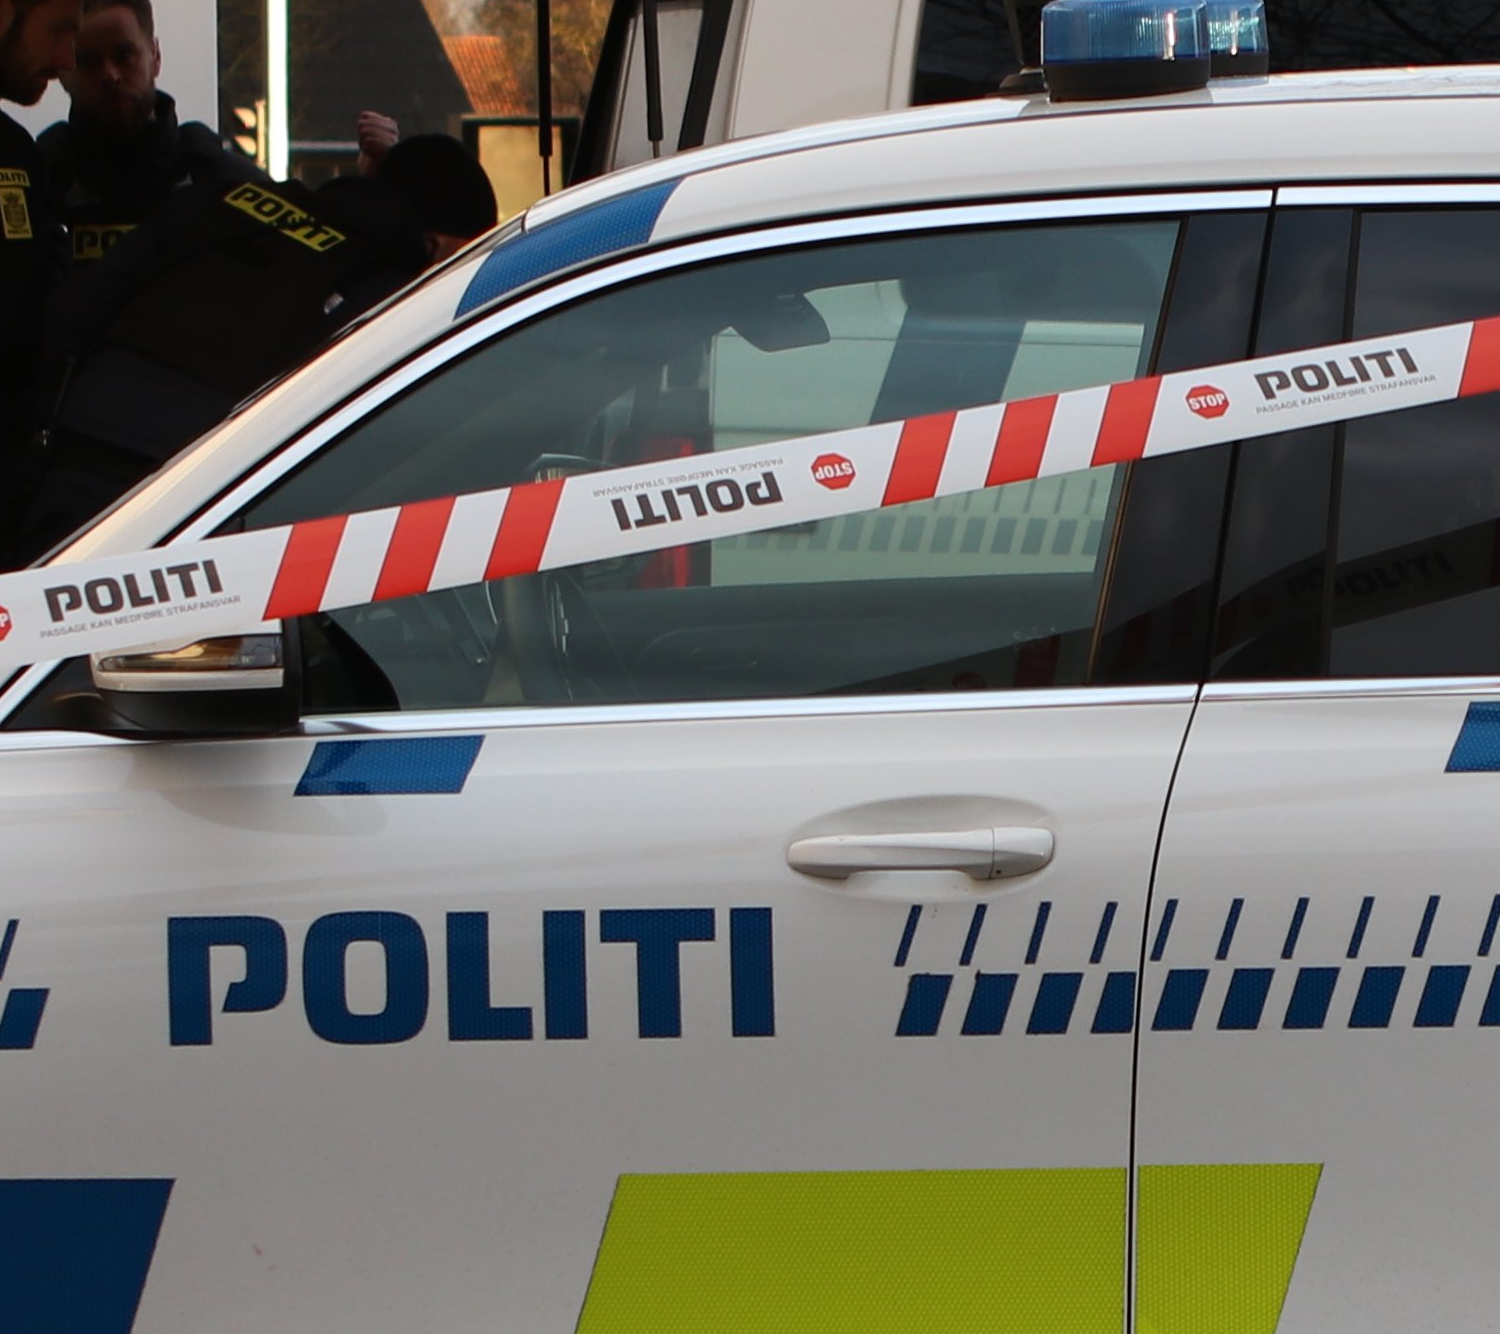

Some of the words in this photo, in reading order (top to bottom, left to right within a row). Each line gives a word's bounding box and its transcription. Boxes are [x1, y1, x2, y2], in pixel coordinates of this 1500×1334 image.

[1253, 347, 1419, 400] POLITI
[1188, 392, 1228, 410] STOP
[1255, 400, 1299, 415] PASSAGE
[1300, 396, 1321, 406] KAN
[1368, 374, 1437, 394] STRAFANSVAR
[715, 465, 737, 476] KAN
[738, 457, 784, 472] PASSAGE
[812, 462, 853, 480] STOP
[592, 478, 664, 498] STRAFANSVAR
[610, 471, 784, 531] POLITI
[43, 559, 223, 623] POLITI
[39, 623, 88, 639] PASSAGE
[90, 619, 112, 630] KAN
[166, 594, 241, 616] STRAFANSVAR
[167, 907, 775, 1046] POLITI
